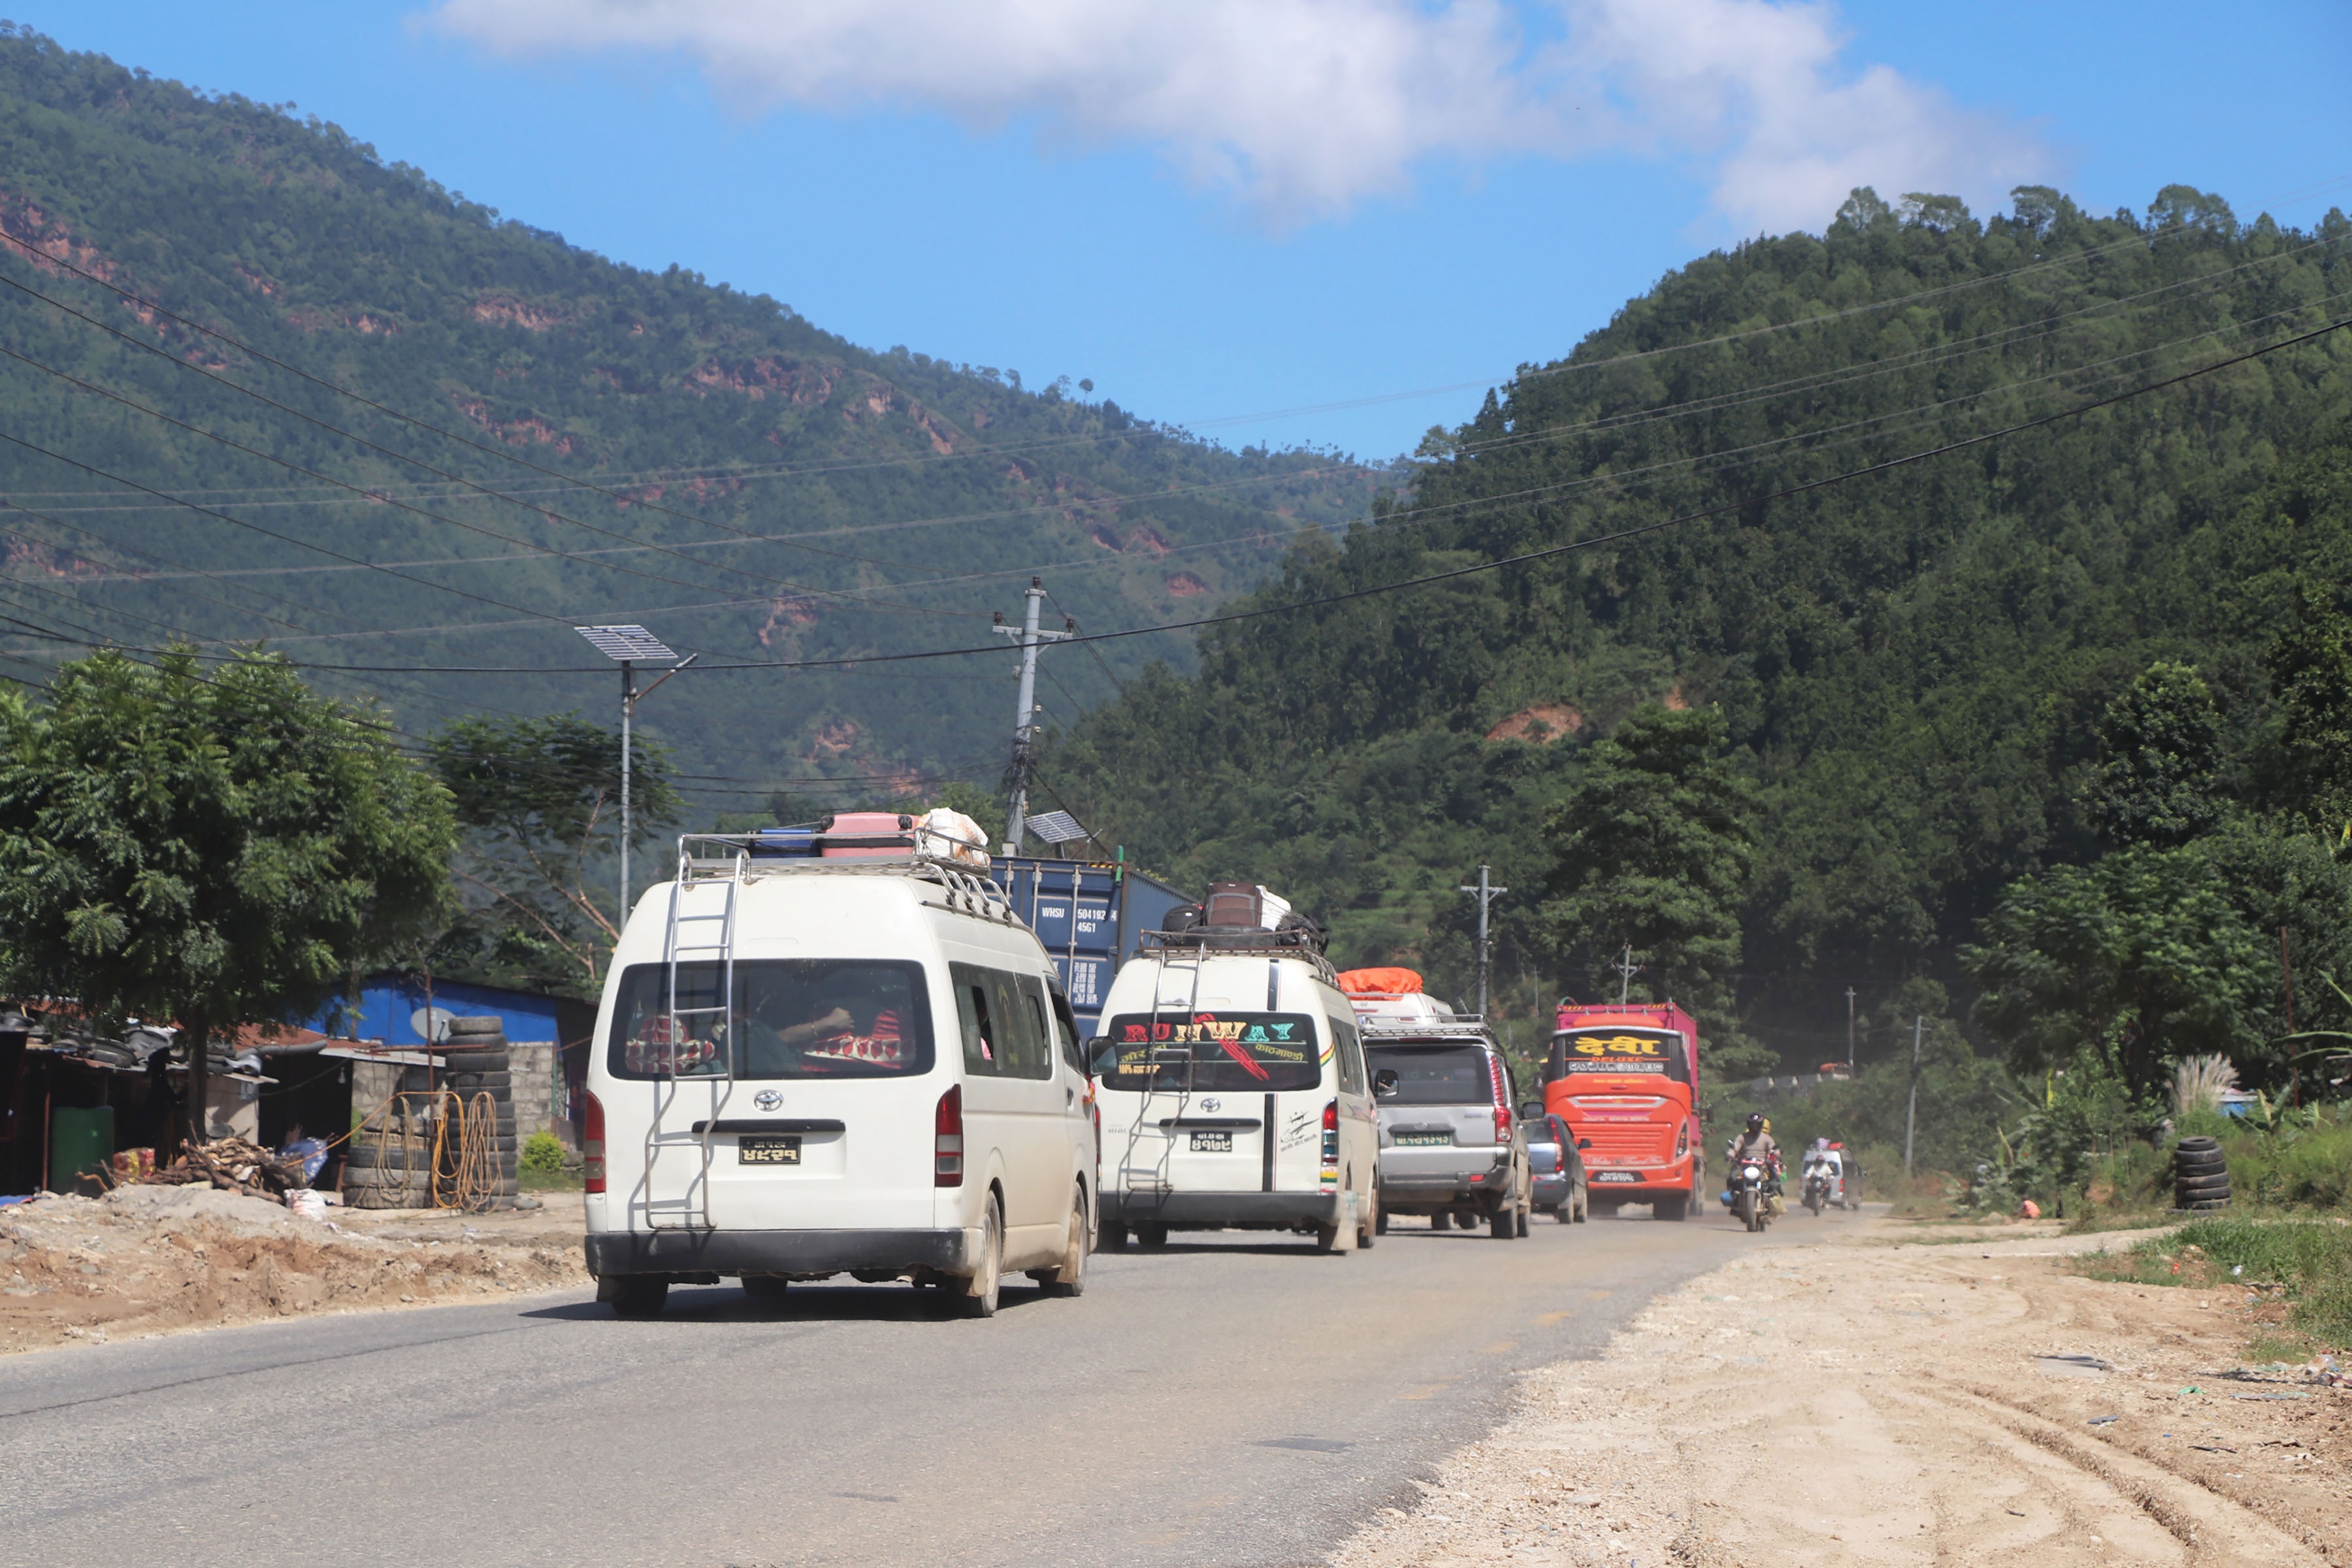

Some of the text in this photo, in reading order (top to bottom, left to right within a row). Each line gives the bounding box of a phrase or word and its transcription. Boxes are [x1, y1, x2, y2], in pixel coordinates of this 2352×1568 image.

[1042, 907, 1064, 917] WHSU
[1077, 909, 1106, 920] 504192
[1077, 922, 1096, 932] 45G1
[1124, 1021, 1294, 1042] RUNWAY
